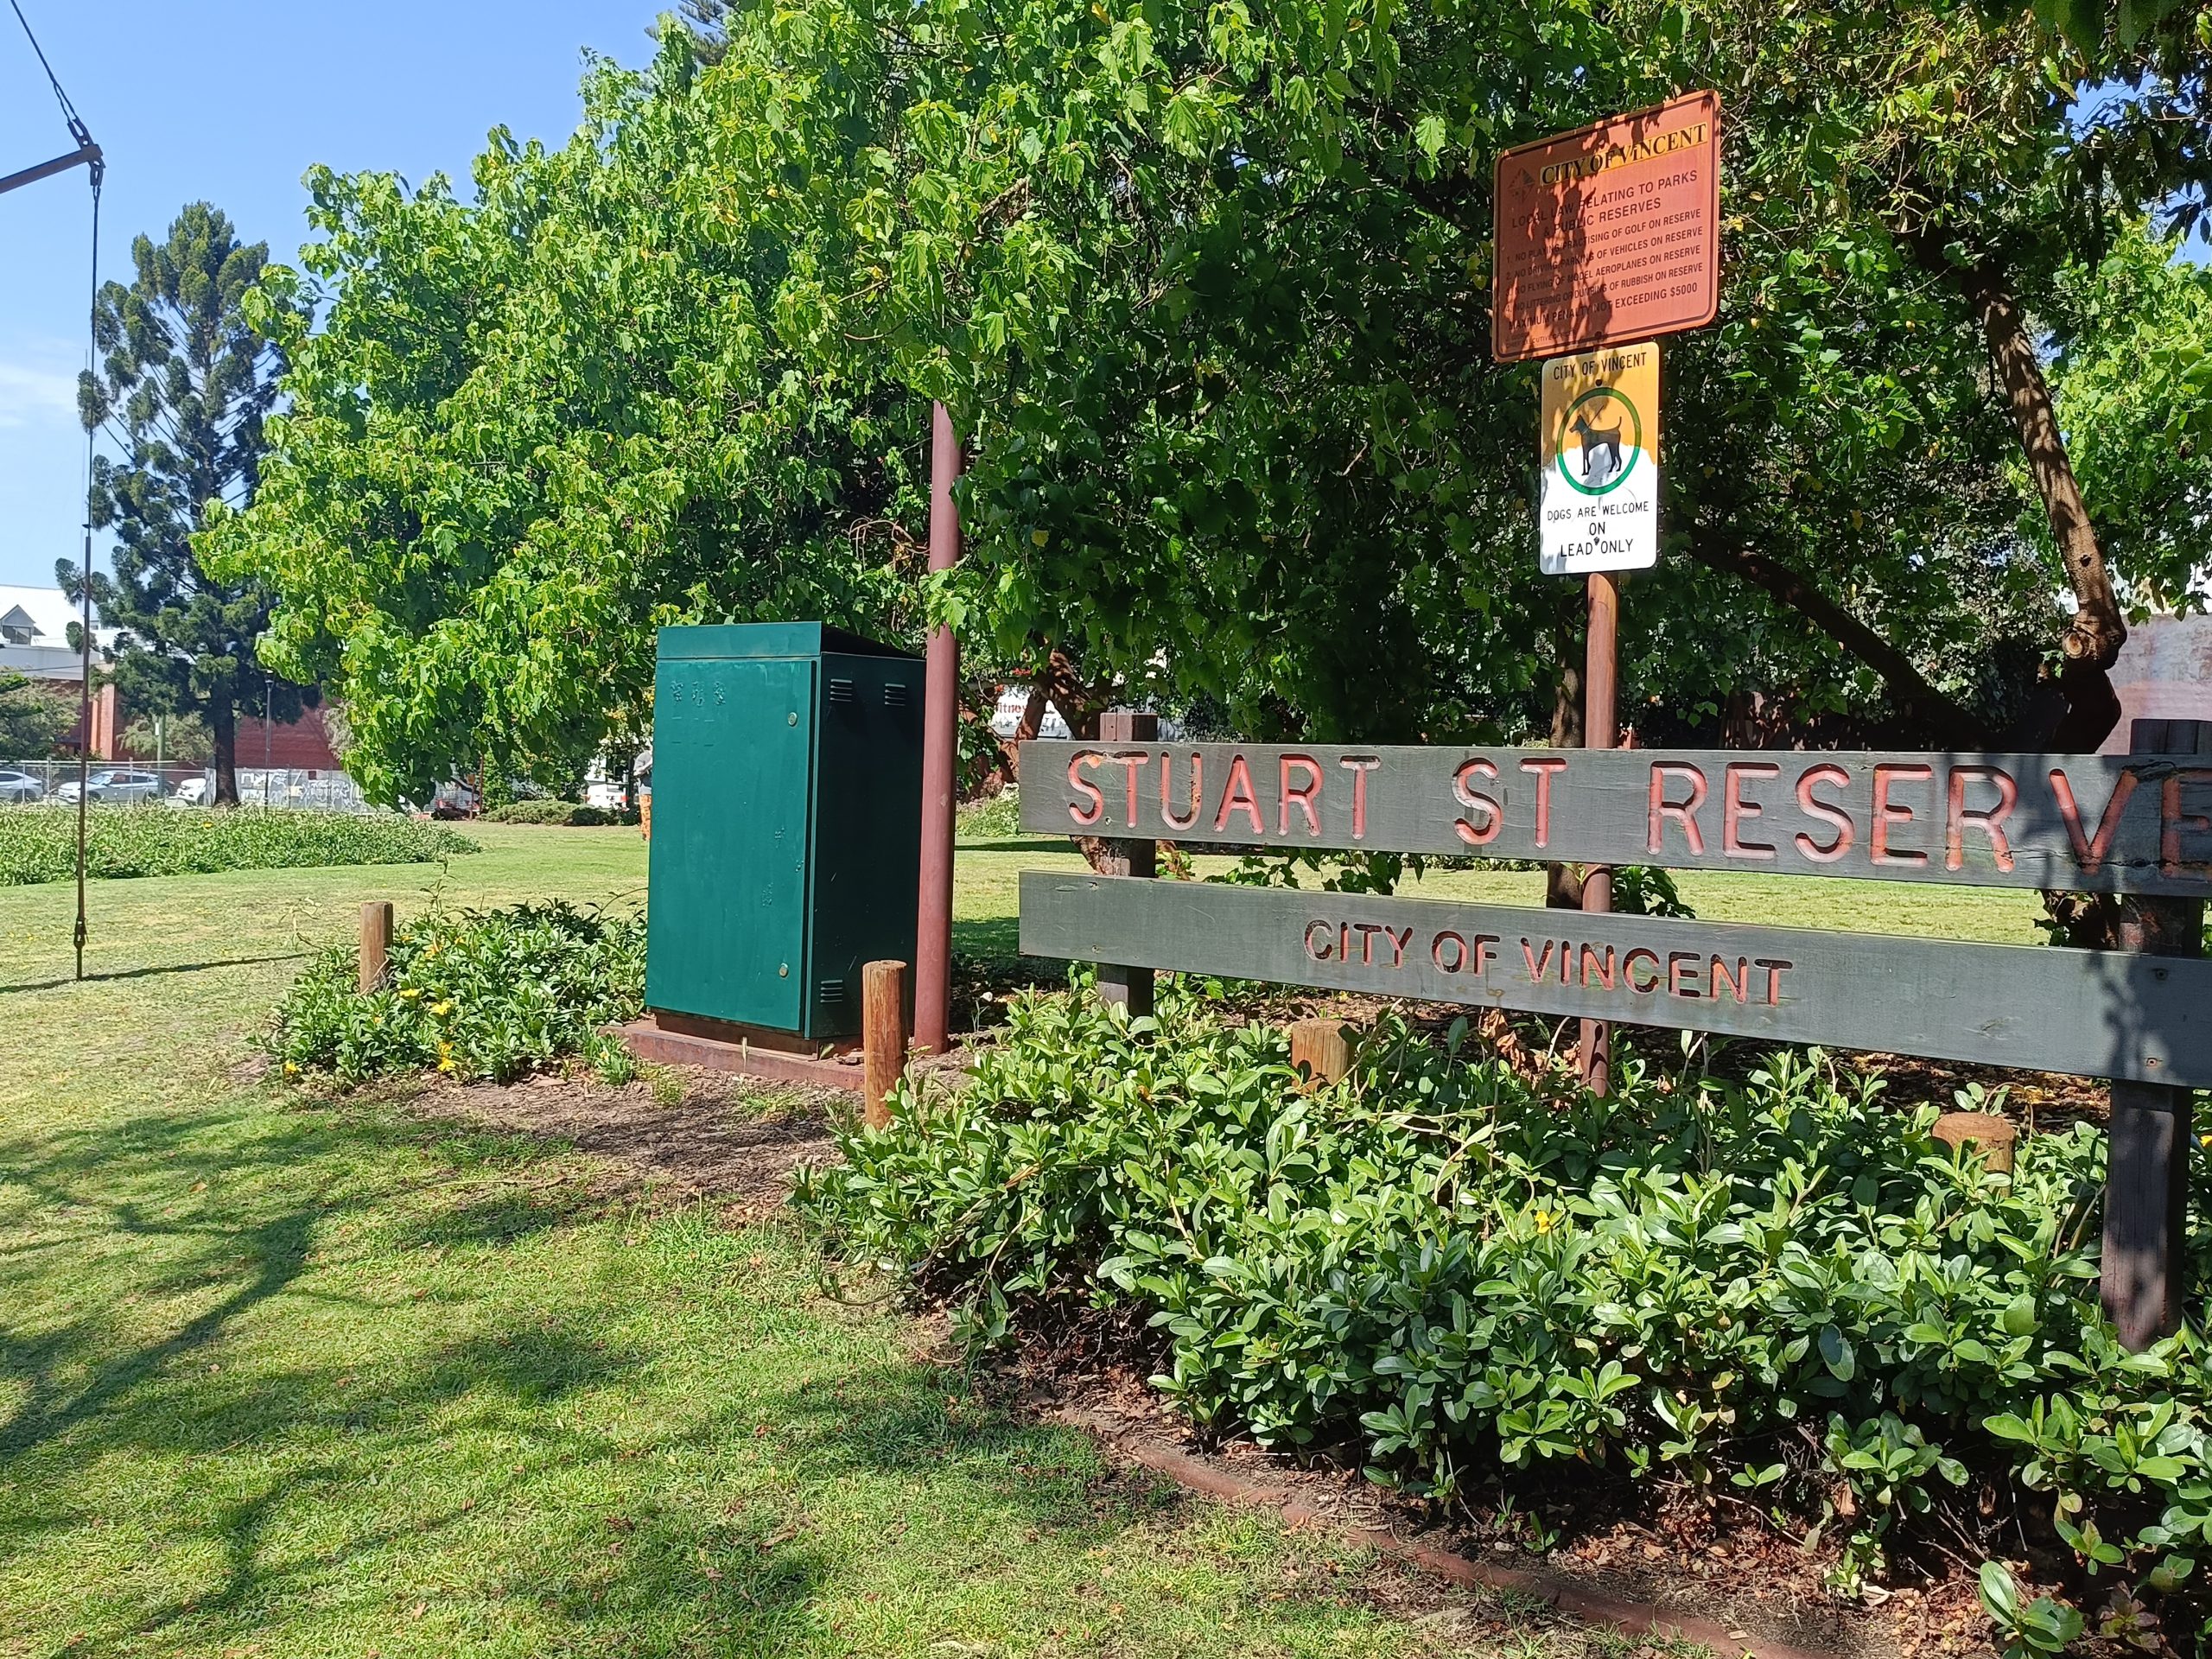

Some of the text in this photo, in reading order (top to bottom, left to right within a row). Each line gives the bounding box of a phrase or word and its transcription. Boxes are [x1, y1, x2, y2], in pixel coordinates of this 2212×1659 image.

[1541, 124, 1707, 184] CITY OF VINCENT
[1512, 169, 1698, 228] LOCAL LAW RELATING TO PARKS
[1554, 214, 1595, 233] PUBLIC
[1599, 197, 1662, 223] RESERVES
[1515, 269, 1527, 278] NO
[1597, 249, 1607, 259] OF
[1610, 239, 1648, 256] VEHICLES
[1650, 236, 1662, 246] ON
[1665, 226, 1703, 244] RESERVE
[1516, 251, 1527, 262] NO
[1611, 227, 1623, 238] OF
[1624, 222, 1646, 235] GOLF
[1649, 219, 1661, 229] ON
[1663, 208, 1701, 226] RESERVE
[1526, 292, 1561, 310] LITTERING
[1610, 280, 1619, 290] OF
[1621, 274, 1654, 289] RUBBISH
[1656, 270, 1667, 281] ON
[1669, 262, 1703, 277] RESERVE
[1528, 279, 1554, 292] FLYING
[1555, 275, 1566, 286] OF
[1568, 270, 1593, 284] MODEL
[1595, 257, 1647, 277] AEROPLANES
[1649, 254, 1662, 264] ON
[1663, 245, 1701, 262] RESERVE
[1509, 282, 1698, 330] MAXIMUM PENALTY NOT EXCEEDING $5000
[1554, 352, 1648, 379] CITY OF VINCENT
[1548, 501, 1649, 521] DOGS ARE WELCOME
[1588, 522, 1606, 536] ON
[1560, 538, 1633, 557] LEAD ONLY
[1066, 748, 2212, 882] STUART ST RESERVE
[1303, 918, 1794, 1007] CITY OF VINCENT
